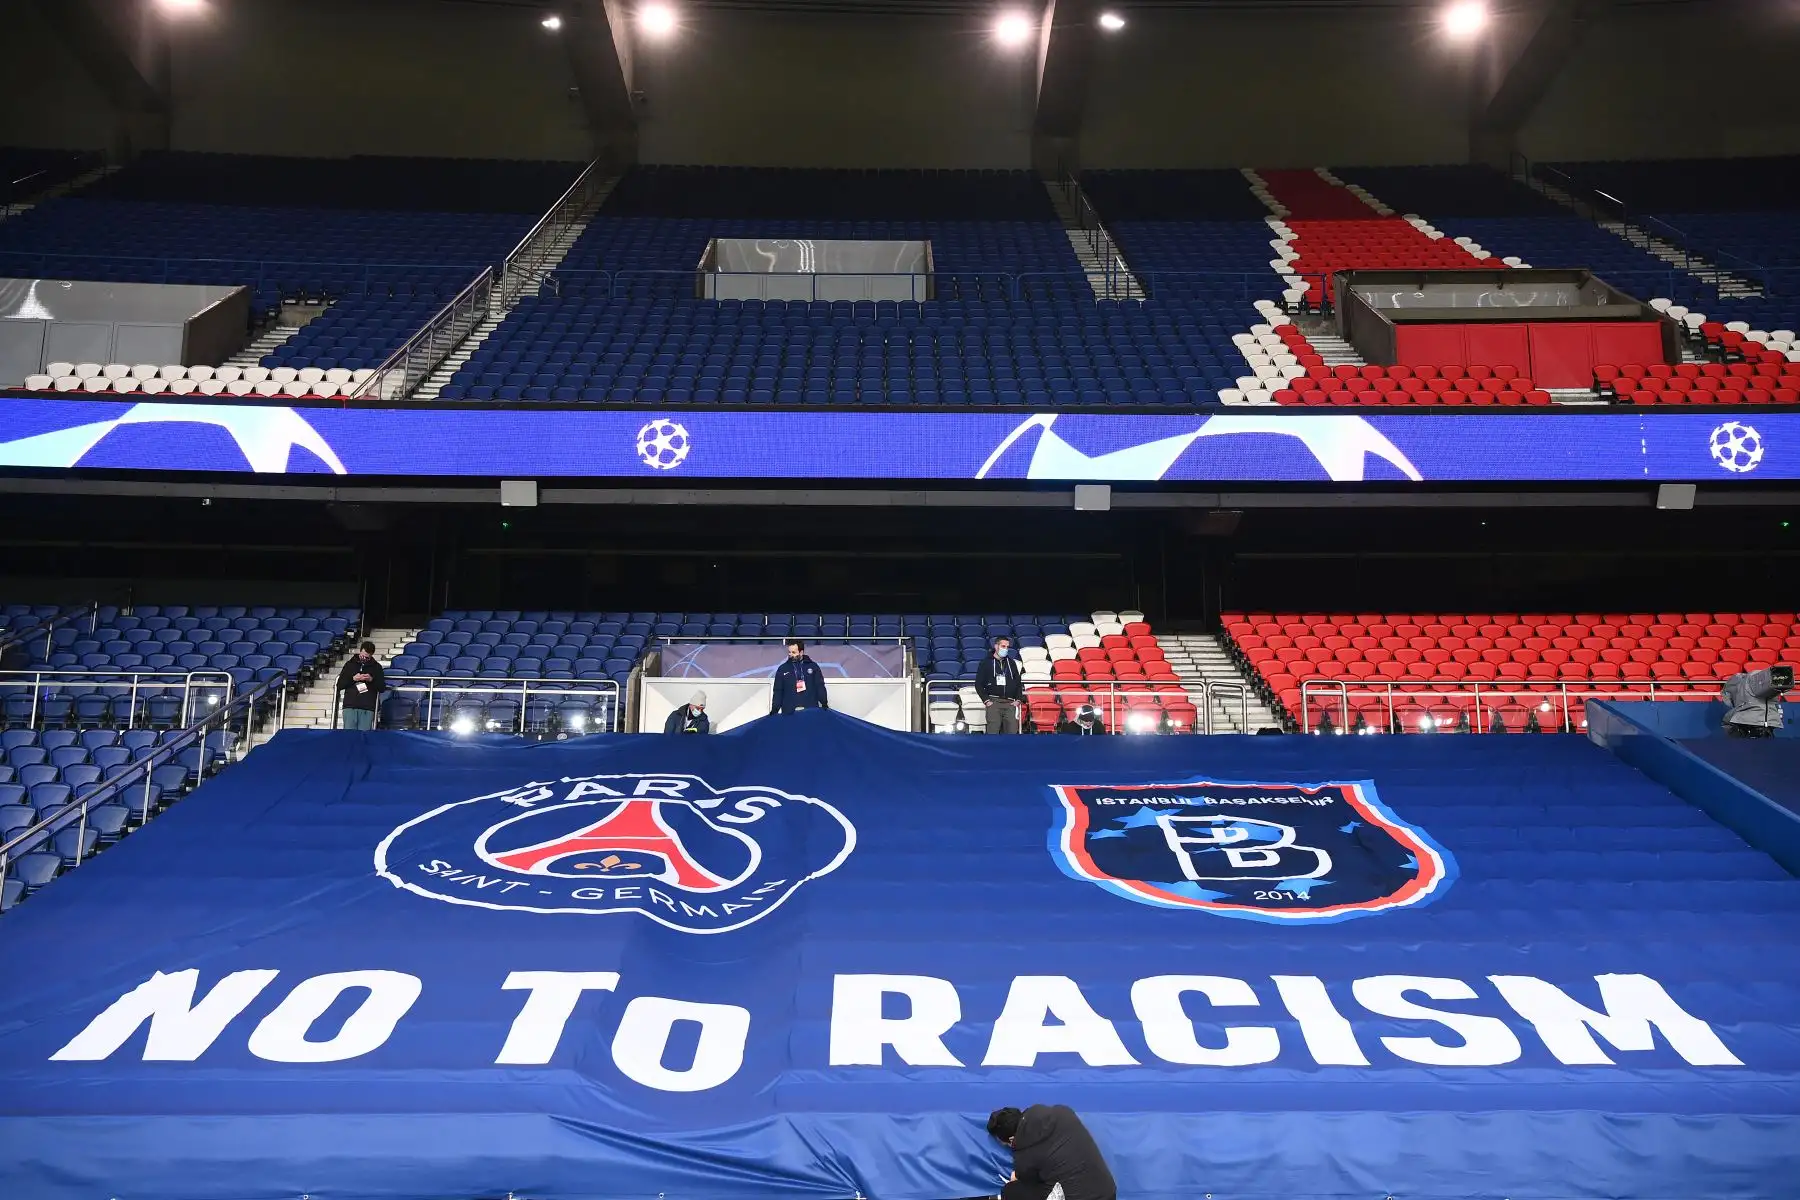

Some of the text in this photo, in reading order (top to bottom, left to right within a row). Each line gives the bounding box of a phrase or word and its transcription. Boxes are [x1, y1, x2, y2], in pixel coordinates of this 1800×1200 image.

[418, 859, 530, 895] SAINT
[571, 879, 786, 918] GERMAIN
[1254, 891, 1310, 899] 2014
[49, 969, 1745, 1091] NO TO RACISM
